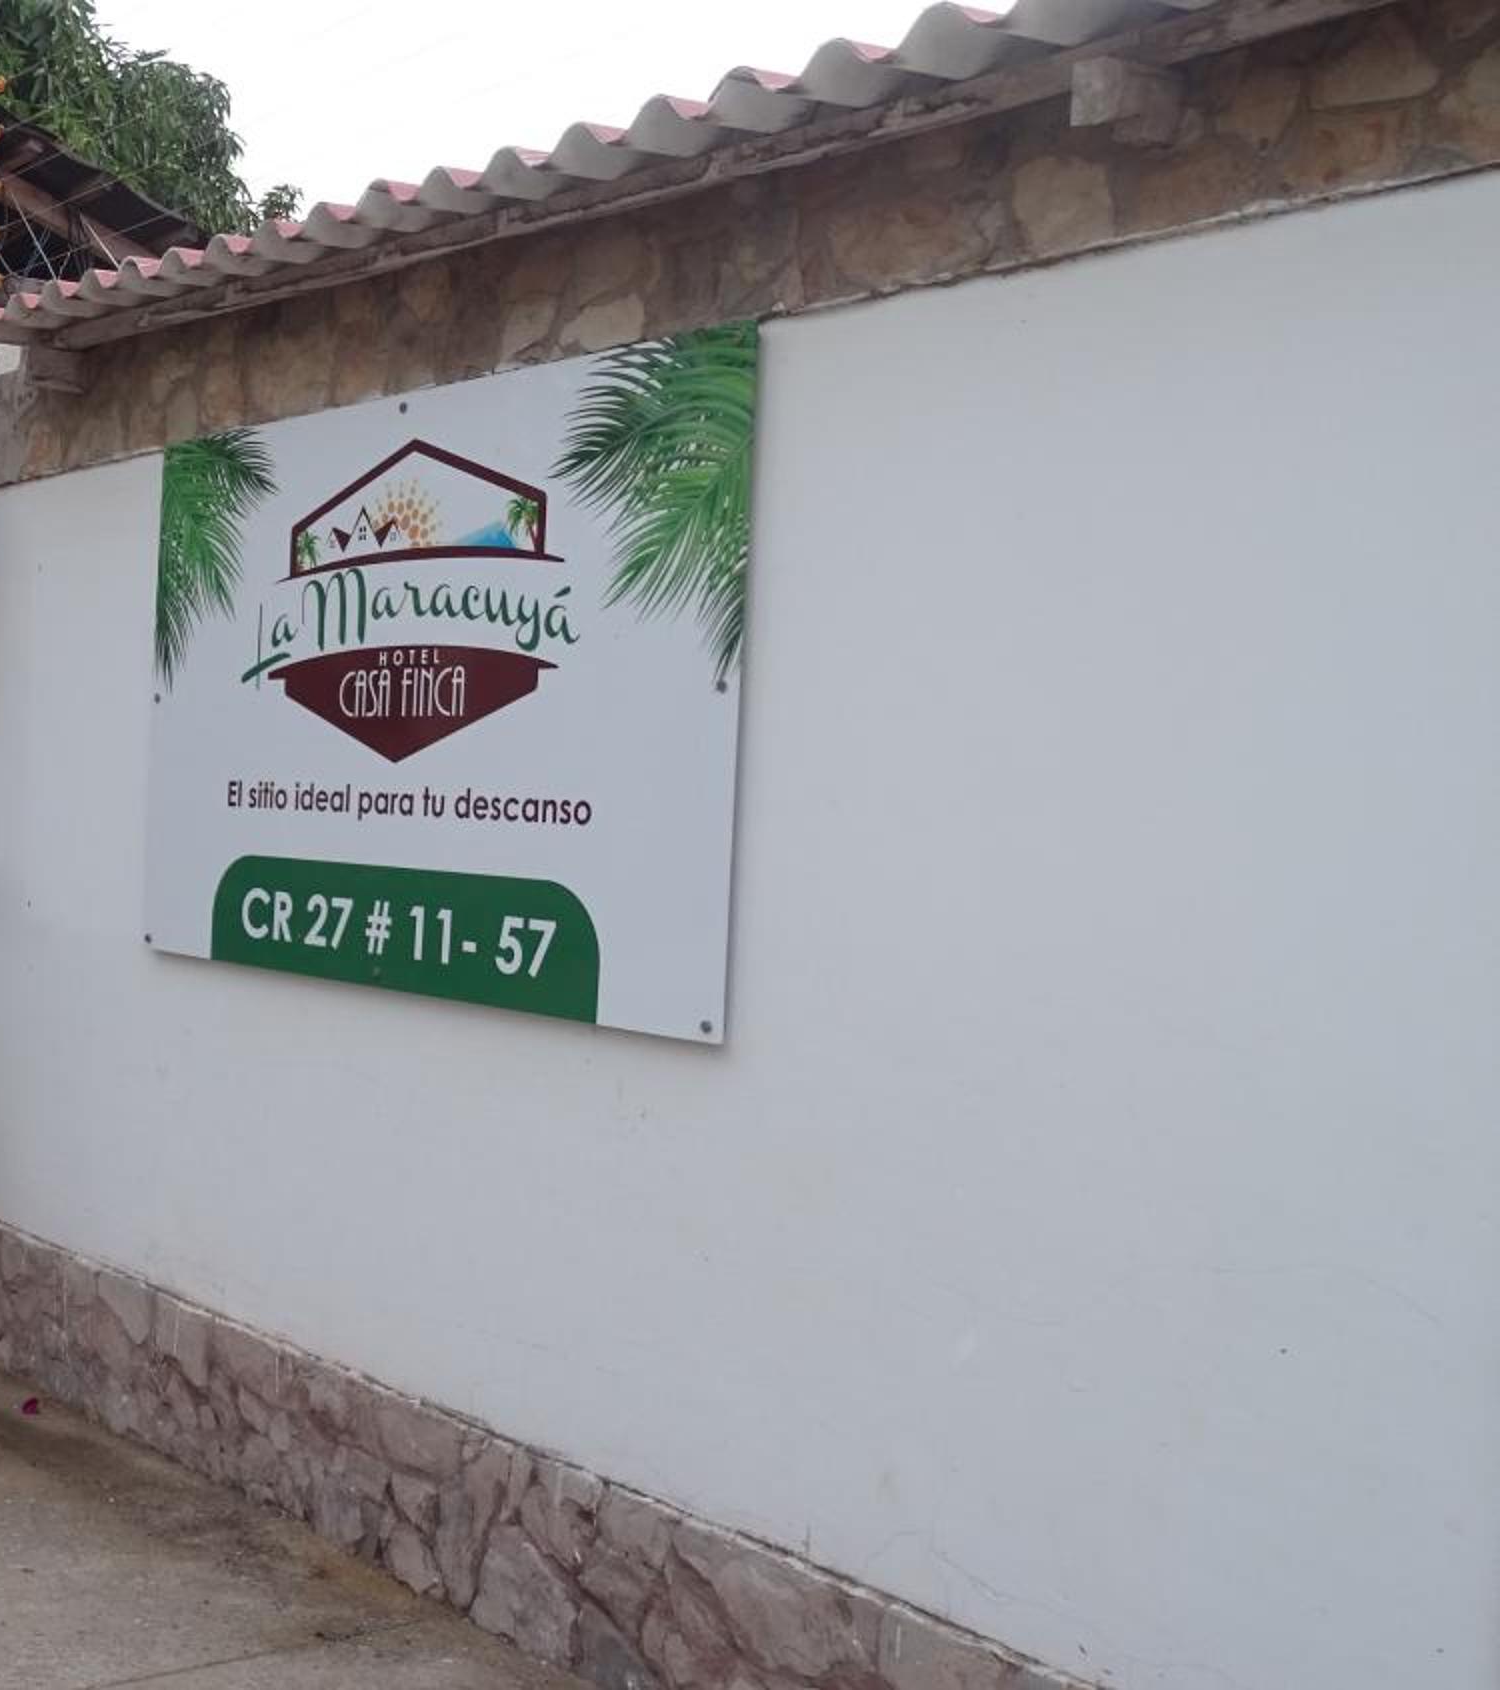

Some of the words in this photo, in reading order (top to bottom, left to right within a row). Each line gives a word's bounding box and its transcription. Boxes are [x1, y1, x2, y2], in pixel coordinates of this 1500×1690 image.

[241, 602, 298, 690] La
[302, 568, 580, 651] Maracuyá
[379, 649, 440, 666] HOTEL
[339, 668, 391, 718] CASA
[401, 665, 465, 717] FINCA
[227, 781, 242, 807] El
[248, 782, 287, 810] sitio
[295, 784, 350, 813] ideal
[358, 790, 413, 820] para
[423, 787, 445, 818] tu
[455, 788, 592, 826] descanso
[241, 887, 293, 943] CR
[304, 894, 353, 950] 27
[365, 900, 392, 955] #
[495, 915, 557, 978] 57
